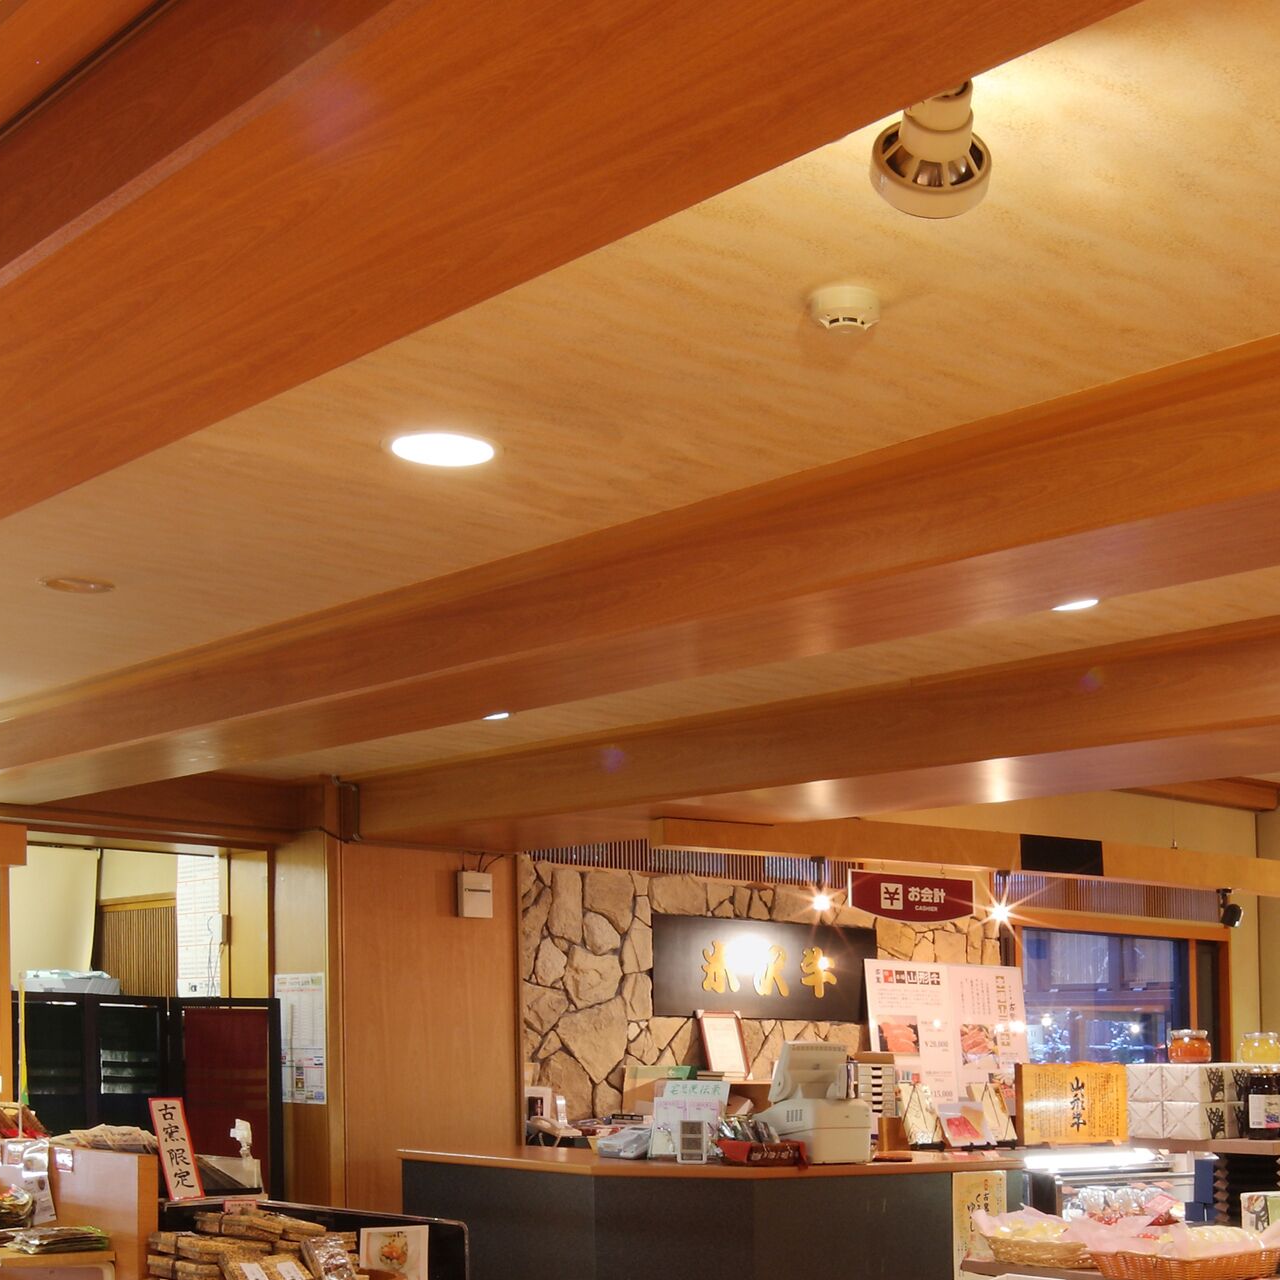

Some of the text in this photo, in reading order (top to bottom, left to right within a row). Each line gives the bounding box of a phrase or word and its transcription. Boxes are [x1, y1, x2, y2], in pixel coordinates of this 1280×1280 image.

[907, 886, 946, 904] お会計
[915, 904, 939, 913] CASHIER
[1070, 1075, 1087, 1133] 山形牛
[157, 1103, 195, 1190] 古窯限定
